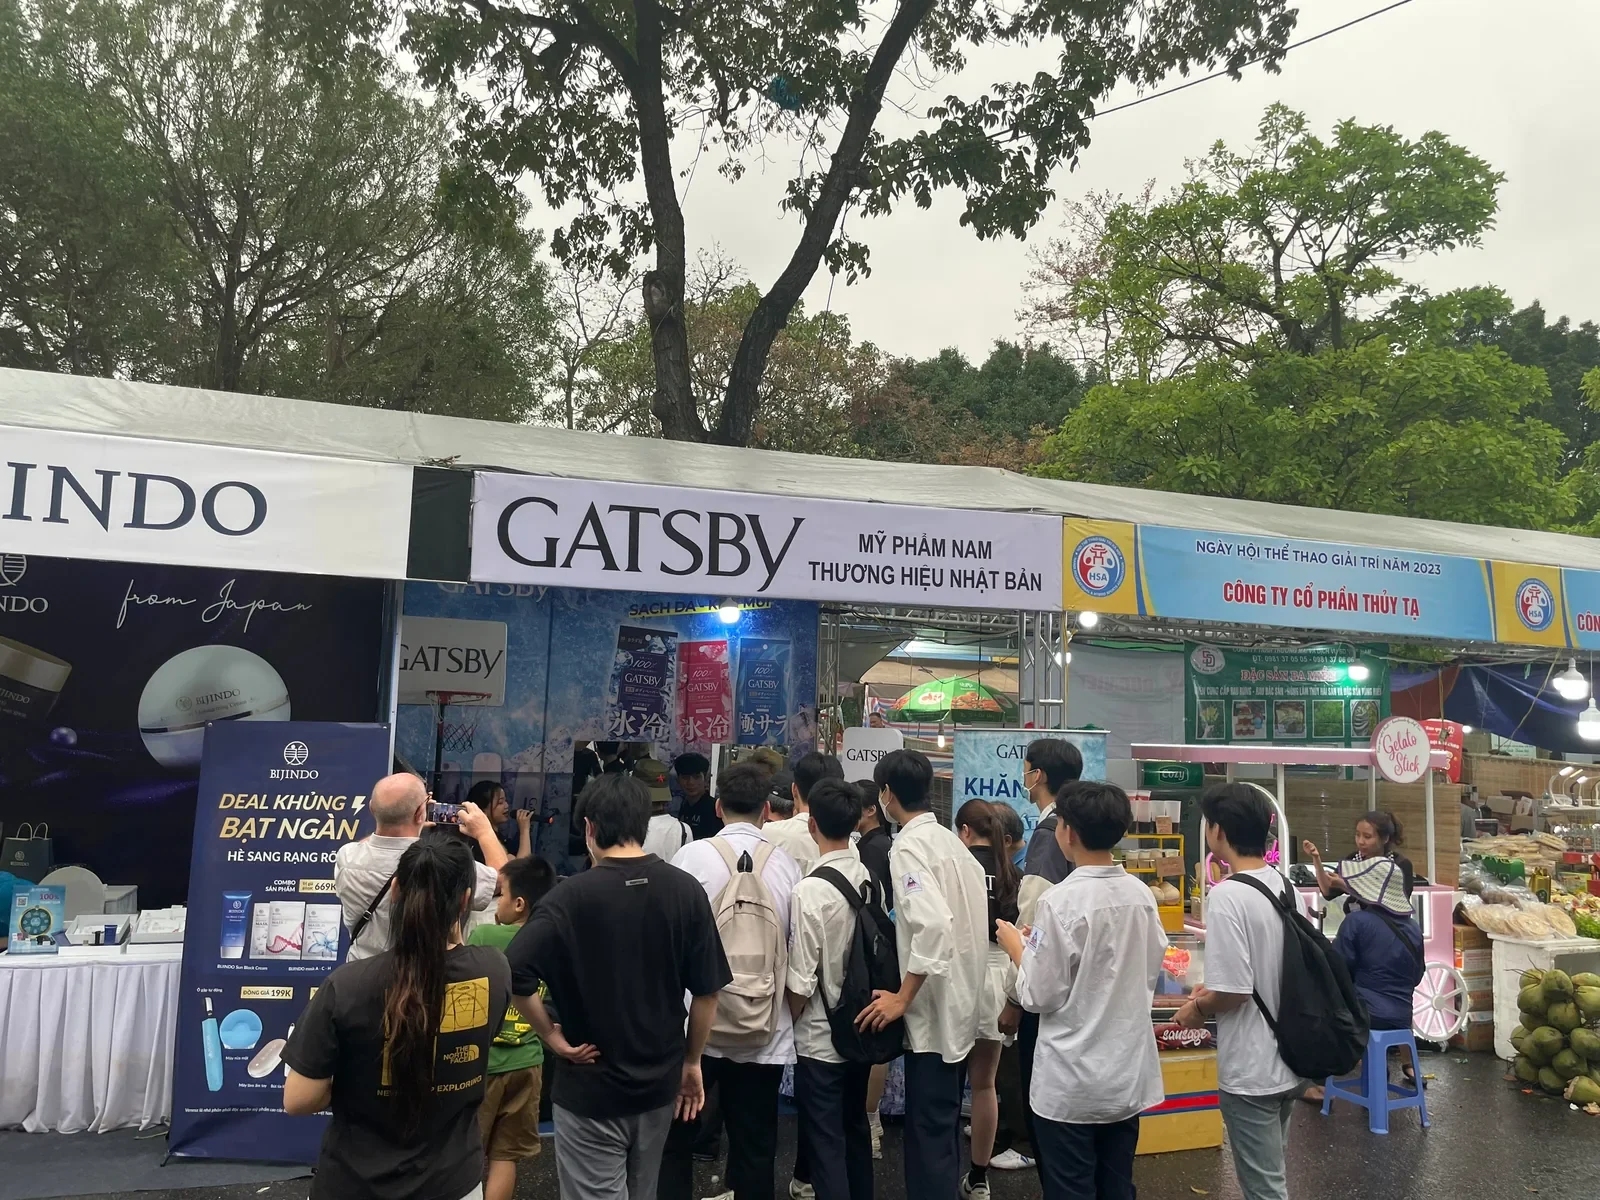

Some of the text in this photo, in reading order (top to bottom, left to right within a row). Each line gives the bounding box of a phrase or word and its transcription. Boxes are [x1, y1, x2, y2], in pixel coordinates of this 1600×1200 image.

[2, 461, 267, 536] INDO
[497, 496, 806, 592] GATSBY
[859, 530, 992, 559] MỸ PHẨM NAM
[1196, 540, 1441, 575] NGÀY HỘI THỂ THAO GIẢI TRÍ NĂM 2023
[808, 561, 1042, 593] THƯƠNG HIỆU NHẬT BẢN
[1089, 572, 1107, 581] HSA
[117, 578, 312, 633] from Japan
[1223, 580, 1420, 620] CÔNG TY CỔ PHẦN THỦY TẠ
[629, 602, 670, 618] SẠCH
[674, 601, 696, 614] DA
[1529, 610, 1542, 618] HSA
[624, 672, 662, 687] GATSBY
[1241, 666, 1265, 684] ĐẶC
[1266, 665, 1289, 681] SẢN
[687, 682, 719, 692] GATSBY
[748, 679, 780, 690] GATSBY
[195, 688, 241, 706] BIJINDO
[608, 709, 668, 740] 氷冷
[680, 714, 730, 741] 氷冷
[996, 744, 1028, 759] GAT
[1382, 728, 1417, 761] Gelato
[1394, 752, 1420, 777] Stick
[269, 769, 319, 781] BIJINDO
[964, 773, 1026, 798] KHĂN
[218, 791, 347, 811] DEAL KHỦNG
[219, 813, 359, 843] BẠT NGÀN
[227, 848, 244, 862] HÈ
[247, 851, 280, 863] SANG
[283, 851, 317, 865] RẠNG
[271, 989, 291, 997] 199K
[1162, 1028, 1211, 1046] sausage
[443, 1051, 469, 1060] NORTH
[455, 1045, 469, 1053] THE
[437, 1074, 483, 1092] EXPLORING
